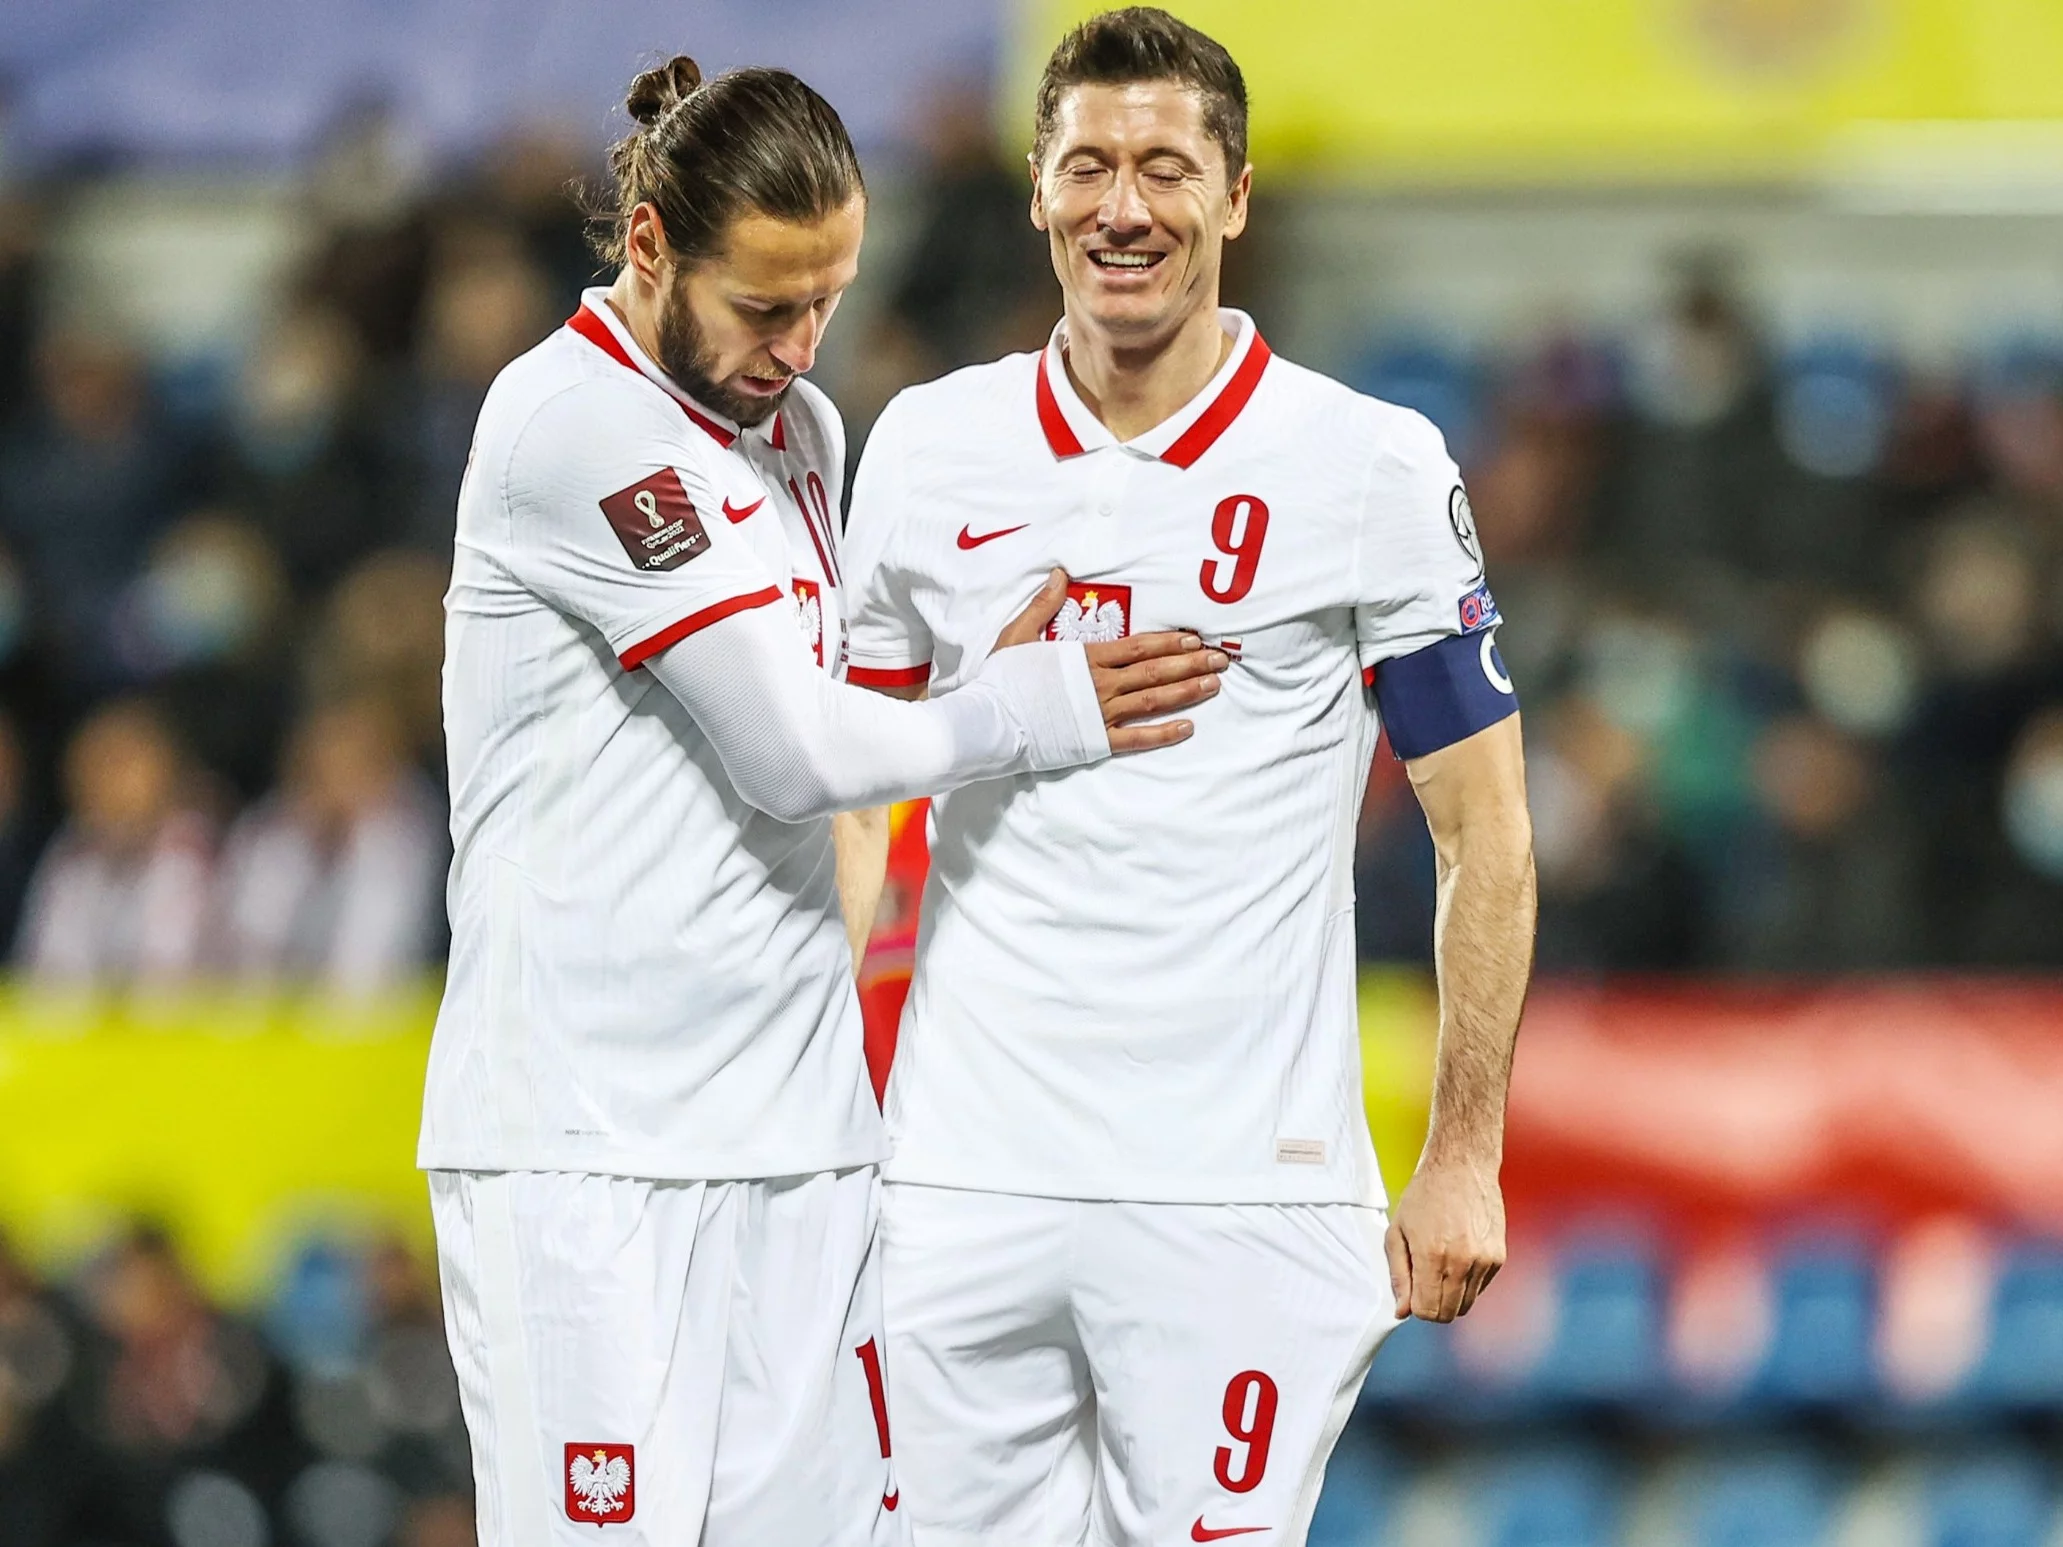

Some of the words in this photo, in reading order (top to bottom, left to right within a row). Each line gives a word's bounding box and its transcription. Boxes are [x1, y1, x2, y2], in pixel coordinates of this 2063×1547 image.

[649, 535, 697, 566] Qualifiers
[1199, 494, 1269, 604] 9
[1214, 1370, 1278, 1493] 9
